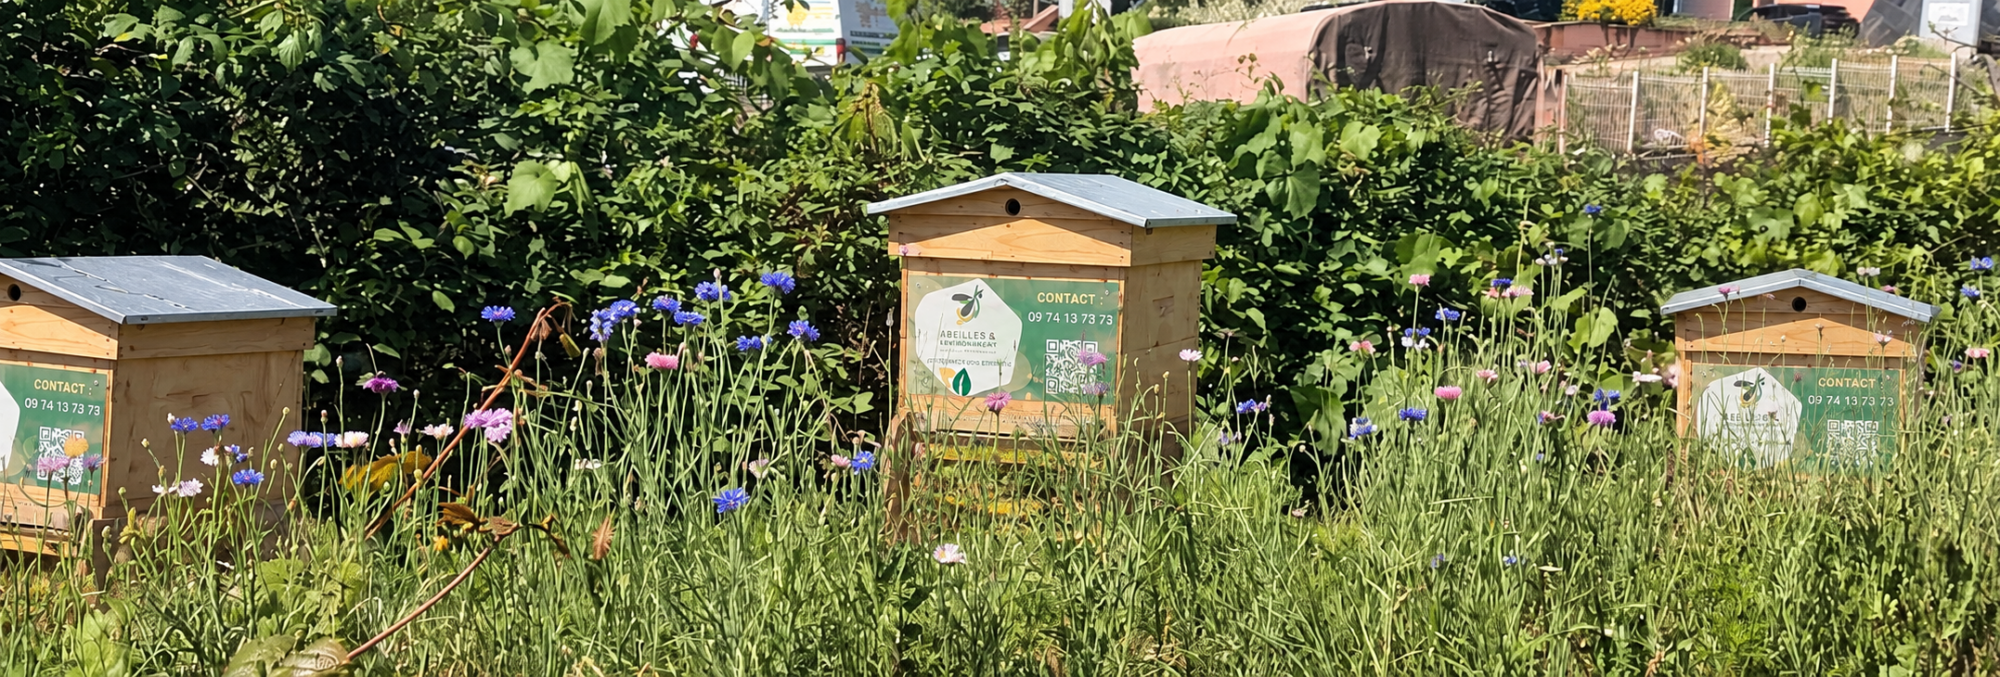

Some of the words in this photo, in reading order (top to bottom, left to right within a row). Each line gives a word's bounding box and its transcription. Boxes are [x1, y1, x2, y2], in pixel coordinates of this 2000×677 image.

[1036, 292, 1096, 305] CONTACT
[1027, 311, 1043, 323] 09
[1045, 312, 1061, 324] 74
[1063, 312, 1078, 324] 13
[1081, 313, 1096, 325] 73
[1099, 314, 1113, 326] 73
[940, 330, 986, 340] ABEILLES
[33, 378, 86, 395] CONTACT
[1818, 377, 1877, 389] CONTACT
[24, 397, 39, 409] 09
[40, 399, 54, 411] 74
[56, 401, 69, 413] 13
[71, 402, 85, 415] 73
[87, 404, 101, 416] 73
[1807, 394, 1823, 405] 09
[1826, 395, 1840, 405] 74
[1844, 395, 1858, 406] 13
[1861, 396, 1876, 407] 73
[1879, 396, 1894, 407] 73
